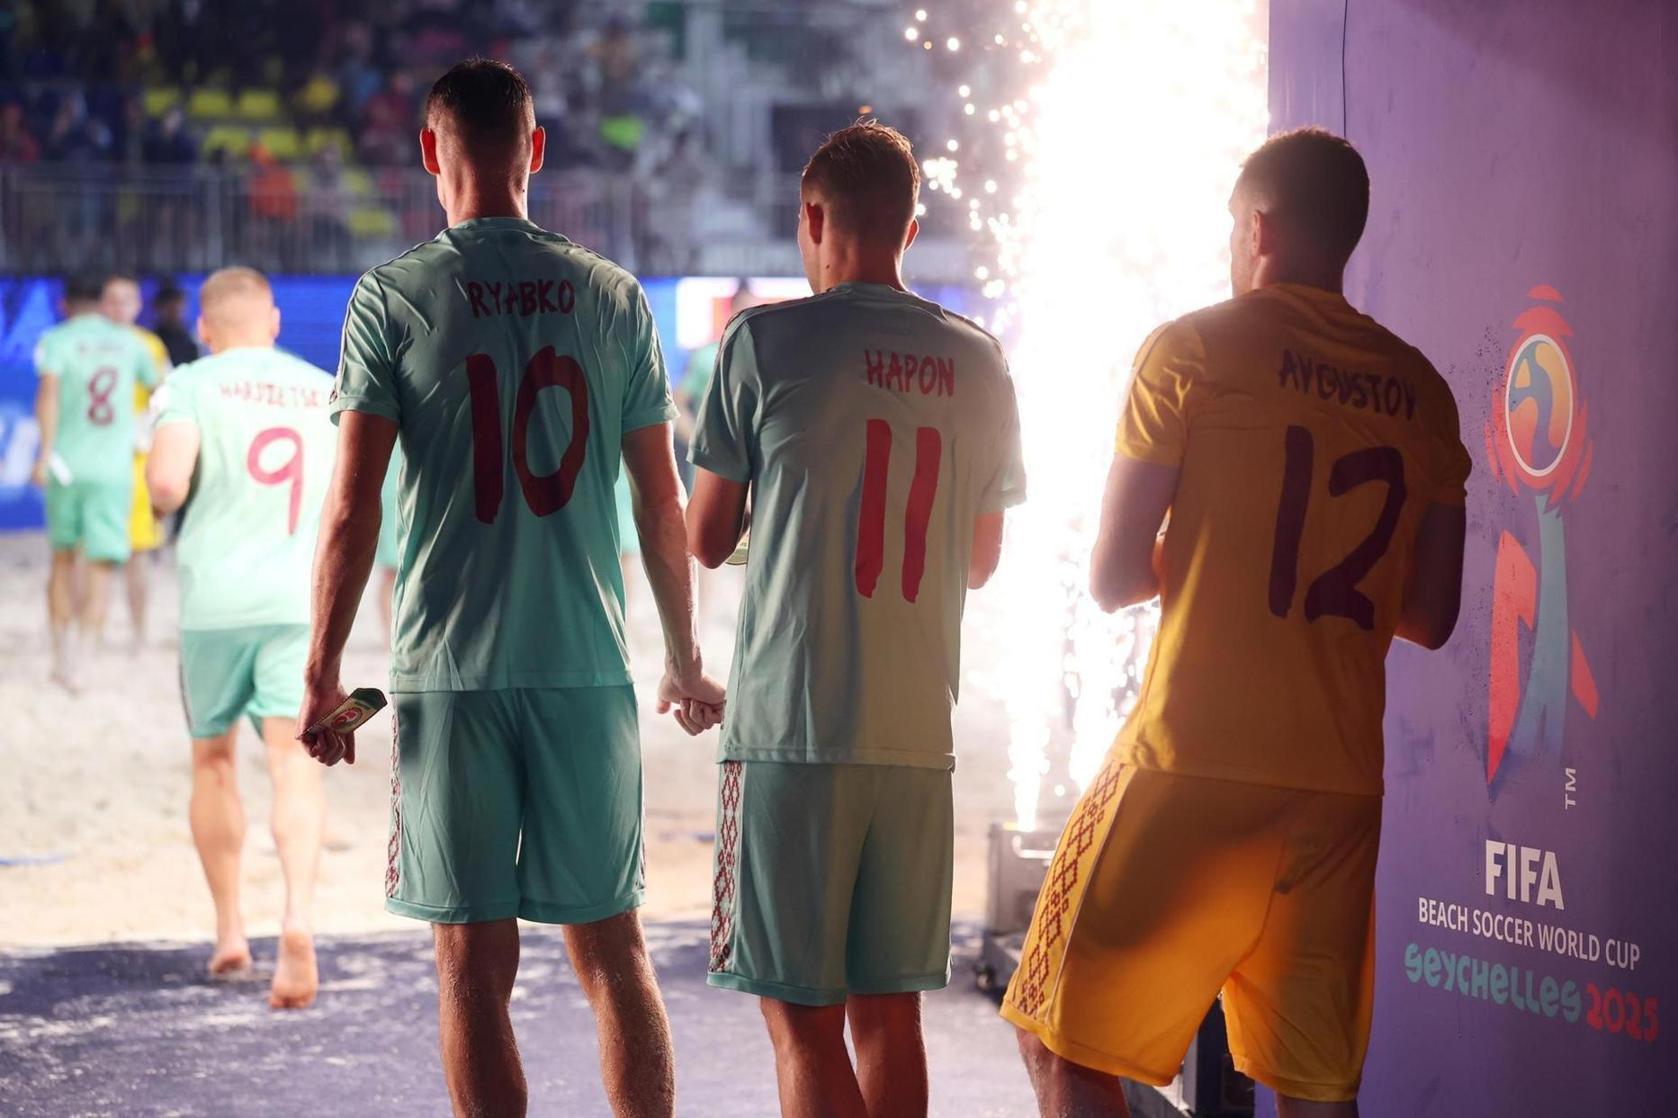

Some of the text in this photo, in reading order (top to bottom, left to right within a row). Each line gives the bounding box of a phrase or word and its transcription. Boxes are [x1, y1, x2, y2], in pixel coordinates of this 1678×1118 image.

[466, 278, 576, 319] RYABKO
[87, 367, 118, 427] 8
[864, 349, 955, 397] HAPON
[1279, 349, 1418, 421] AVGUSTOV
[465, 345, 590, 525] 10
[247, 427, 304, 536] 9
[855, 418, 942, 604] 11
[1268, 425, 1407, 631] 12
[1565, 767, 1576, 811] TM
[1485, 839, 1565, 911] FIFA
[1418, 897, 1641, 971] BEACH SOCCER WORLD CUP
[1586, 982, 1660, 1043] 2025
